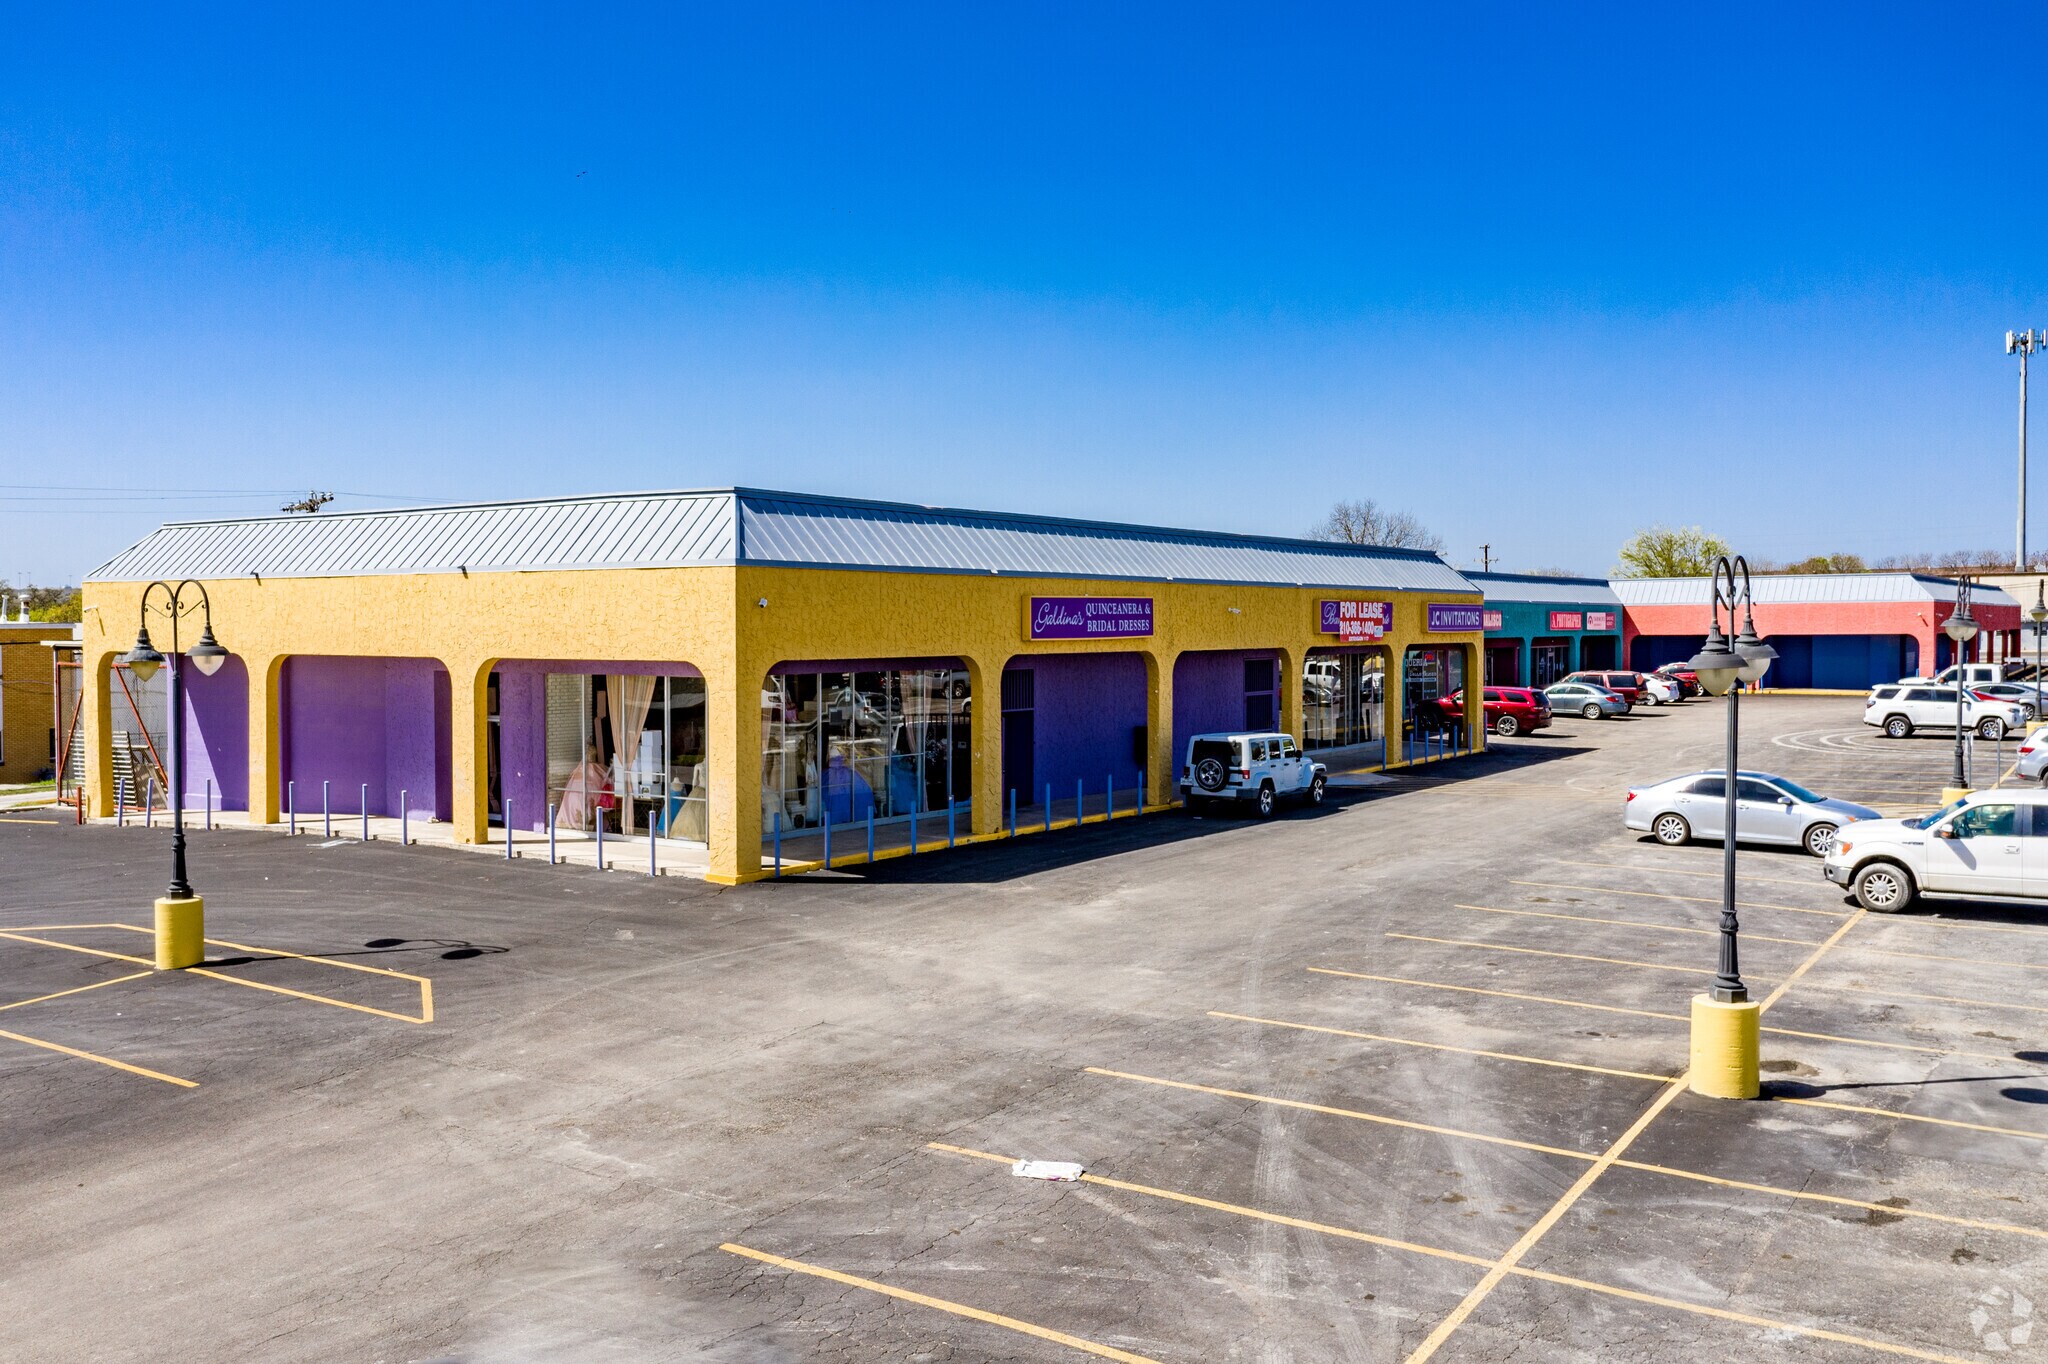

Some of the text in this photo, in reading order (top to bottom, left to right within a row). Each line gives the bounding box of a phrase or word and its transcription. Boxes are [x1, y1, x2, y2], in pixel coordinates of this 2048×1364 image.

[1085, 603, 1151, 616] QUINCEANERA &
[1340, 602, 1356, 618] FOR
[1359, 602, 1383, 619] LEASE
[1087, 619, 1149, 632] BRIDAL DRESSES
[1431, 611, 1480, 626] JC INVITATIONS
